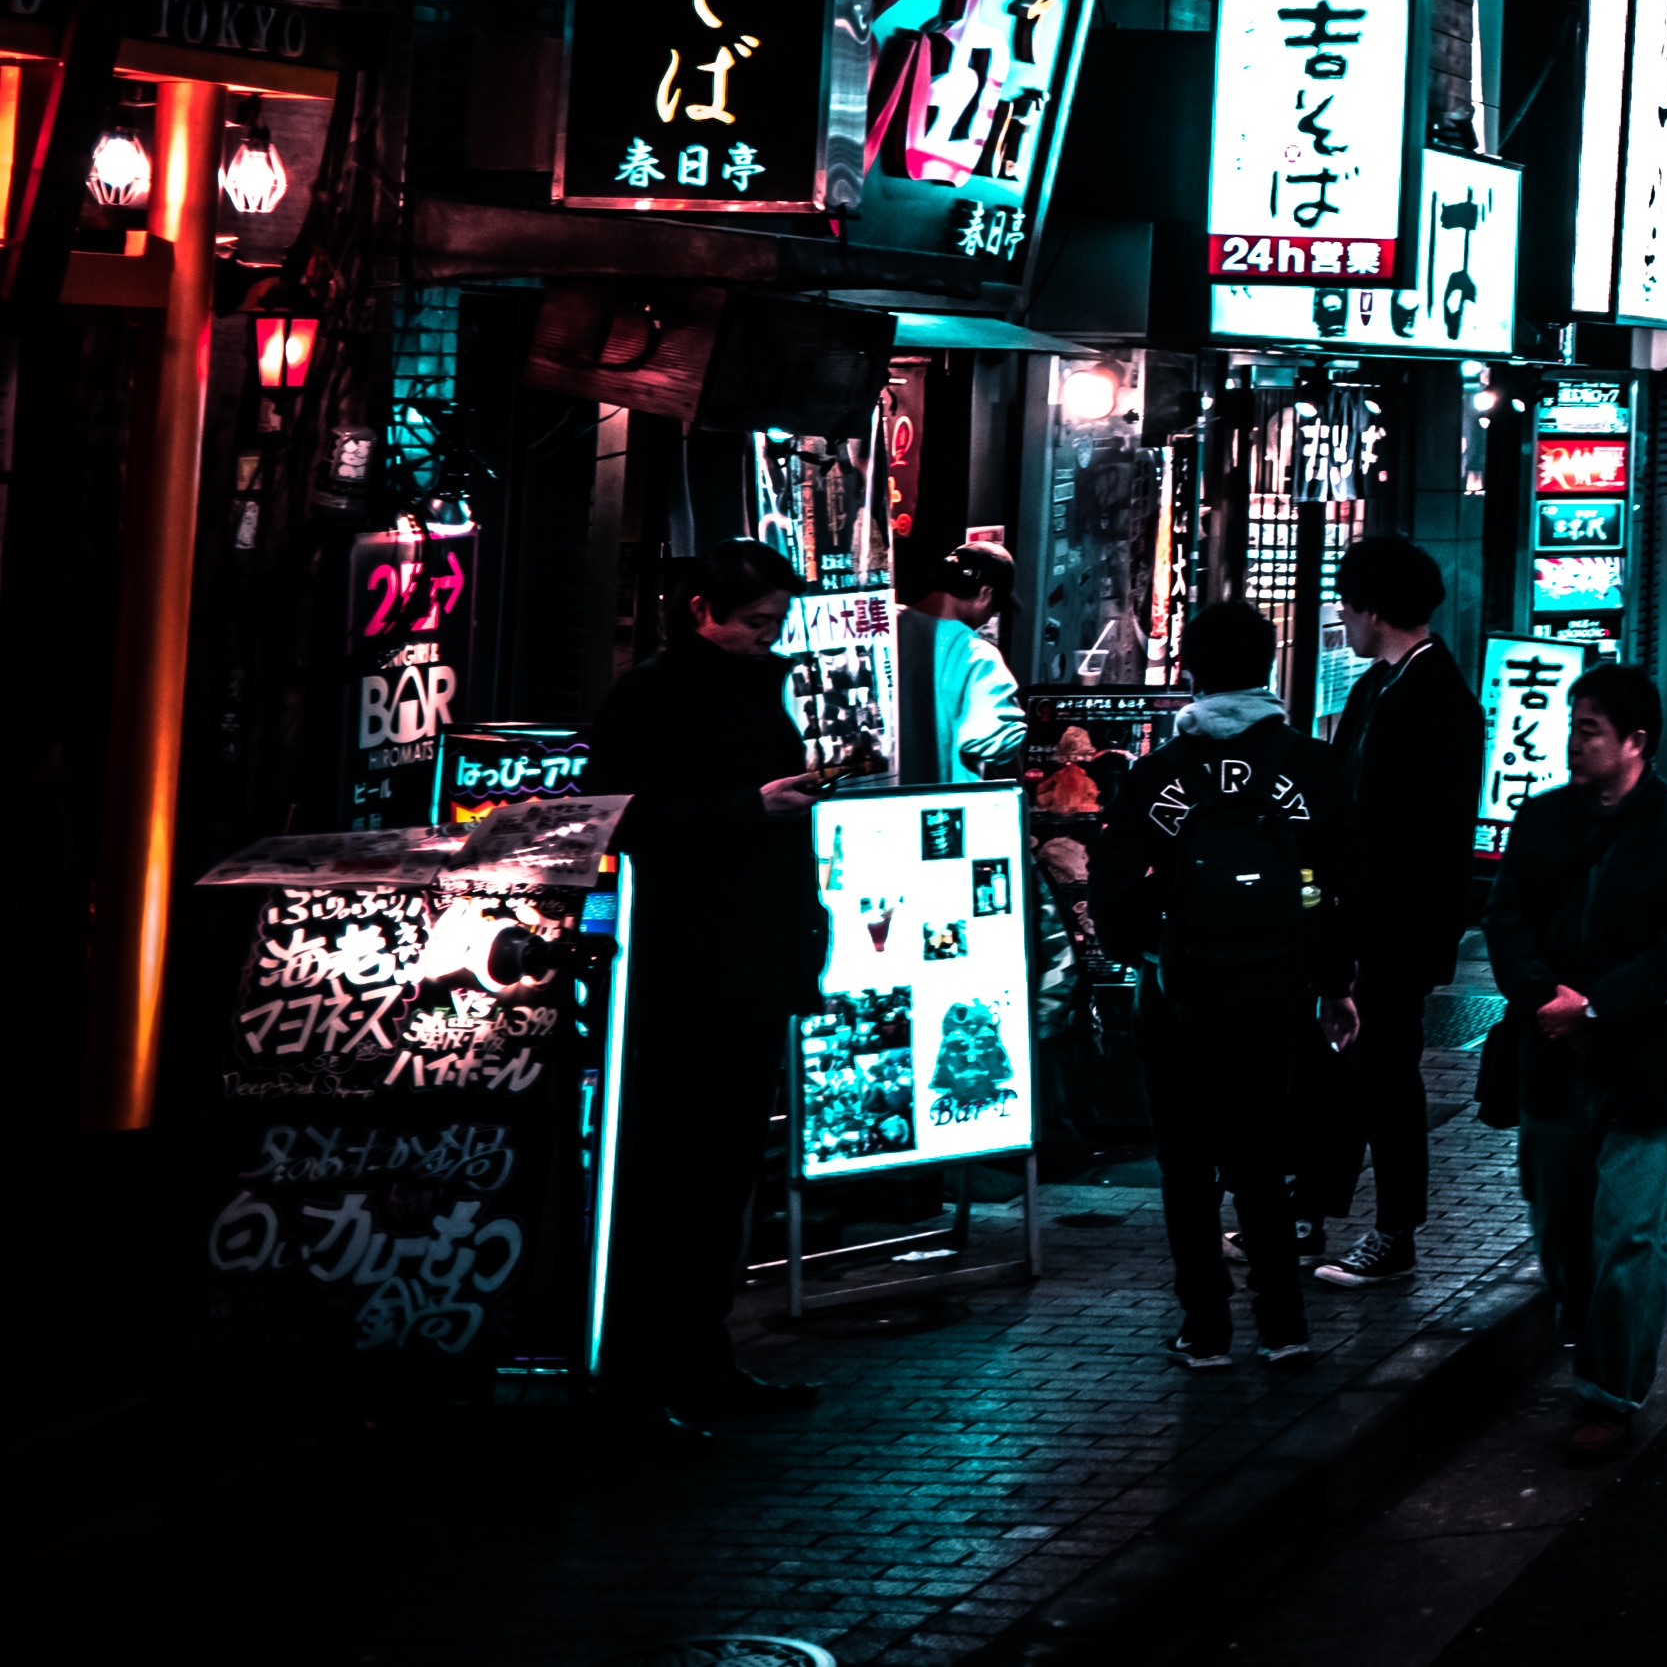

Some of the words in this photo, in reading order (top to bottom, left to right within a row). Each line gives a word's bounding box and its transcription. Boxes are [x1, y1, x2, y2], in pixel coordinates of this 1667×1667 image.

[1274, 0, 1368, 229] 吉そば
[615, 137, 767, 191] 春日亭
[957, 201, 1027, 262] 春日亭
[1221, 237, 1383, 277] 24h営業
[359, 665, 457, 751] BAR
